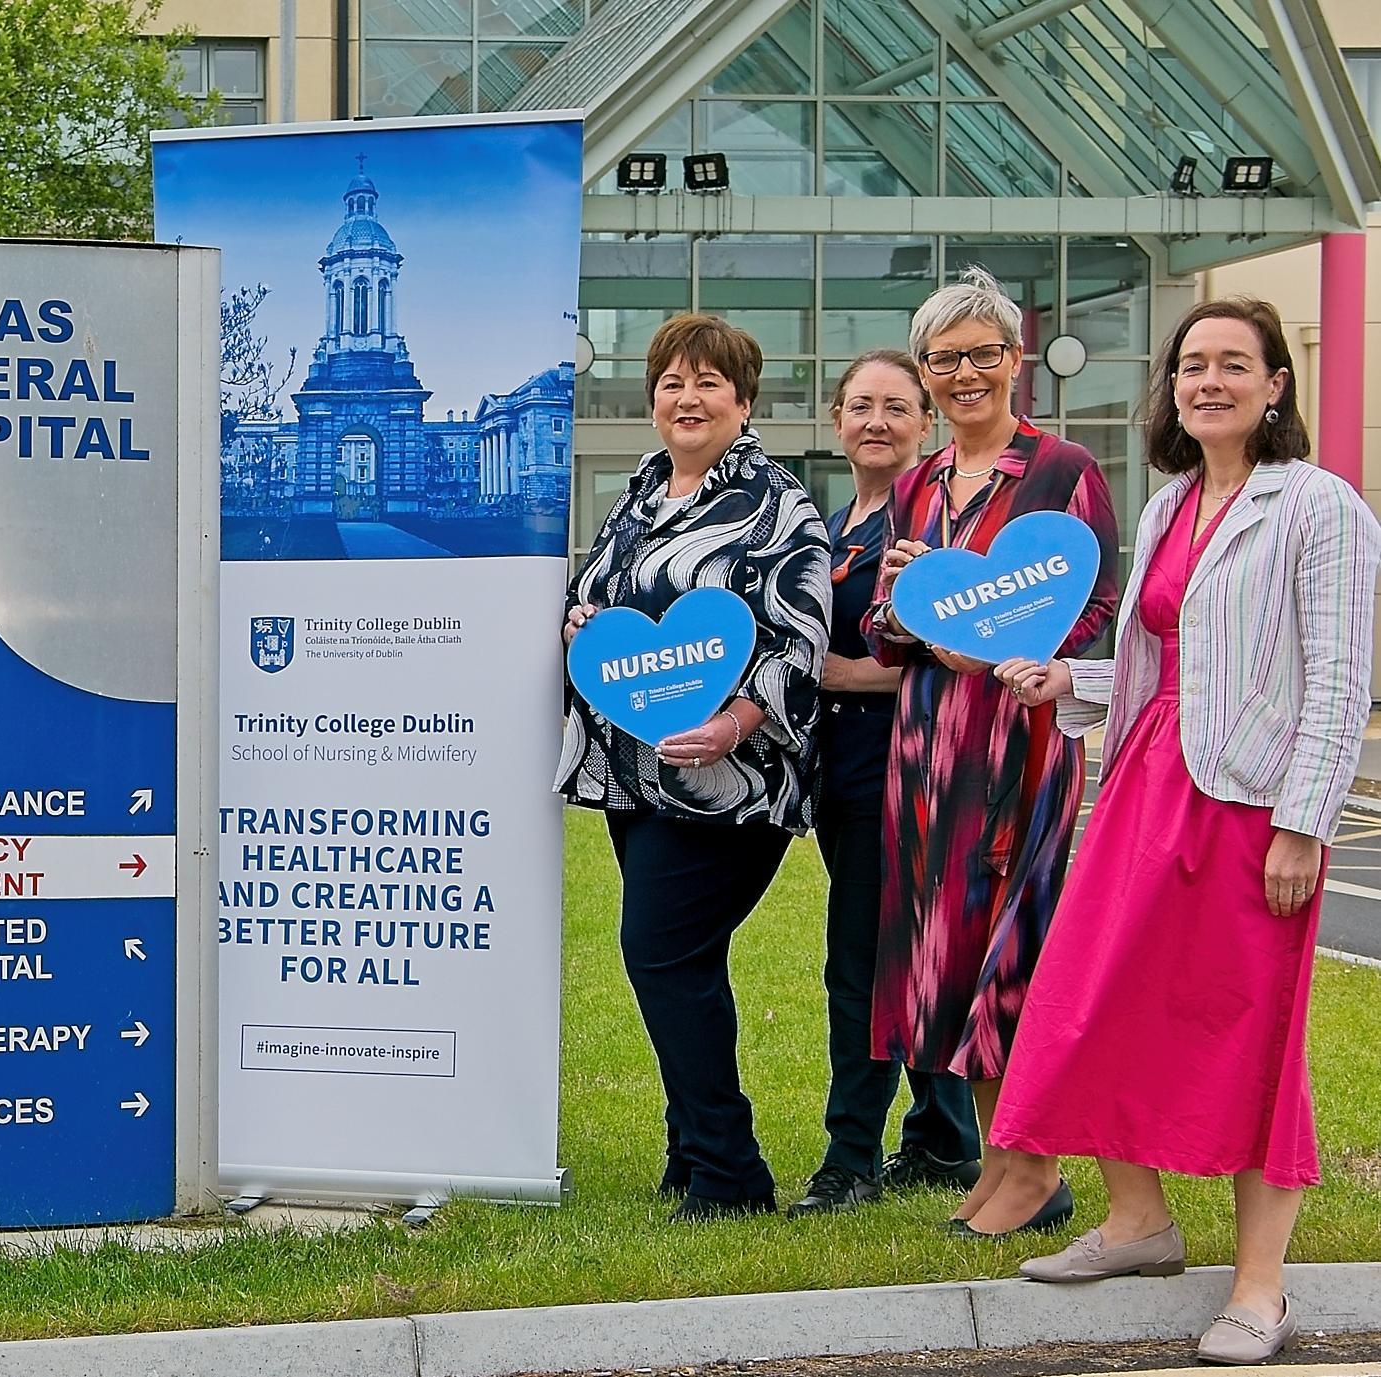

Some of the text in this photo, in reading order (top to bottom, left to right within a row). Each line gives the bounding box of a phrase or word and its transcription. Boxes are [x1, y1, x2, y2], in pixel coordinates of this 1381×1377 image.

[933, 555, 1069, 620] NURSING
[994, 610, 1012, 621] Trinity
[1013, 603, 1033, 614] College
[305, 617, 461, 633] Trinity College Dublin
[305, 636, 338, 645] Coláiste
[351, 635, 393, 646] Tríonóide,
[395, 635, 416, 644] Baile
[417, 634, 436, 644] Átha
[437, 635, 462, 644] Cliath
[306, 650, 403, 660] The University of Dublin
[601, 637, 725, 684] NURSING
[648, 687, 666, 695] Trinity
[234, 713, 474, 738] Trinity College Dublin
[231, 744, 477, 766] School of Nursing & Midwifery
[219, 808, 490, 837] TRANSFORMING
[242, 845, 463, 874] HEALTHCARE
[291, 882, 462, 912] CREATING
[473, 885, 494, 912] A
[354, 920, 491, 950] FUTURE
[281, 956, 420, 985] FOR ALL
[256, 1040, 440, 1062] #imagine-innovate-inspire
